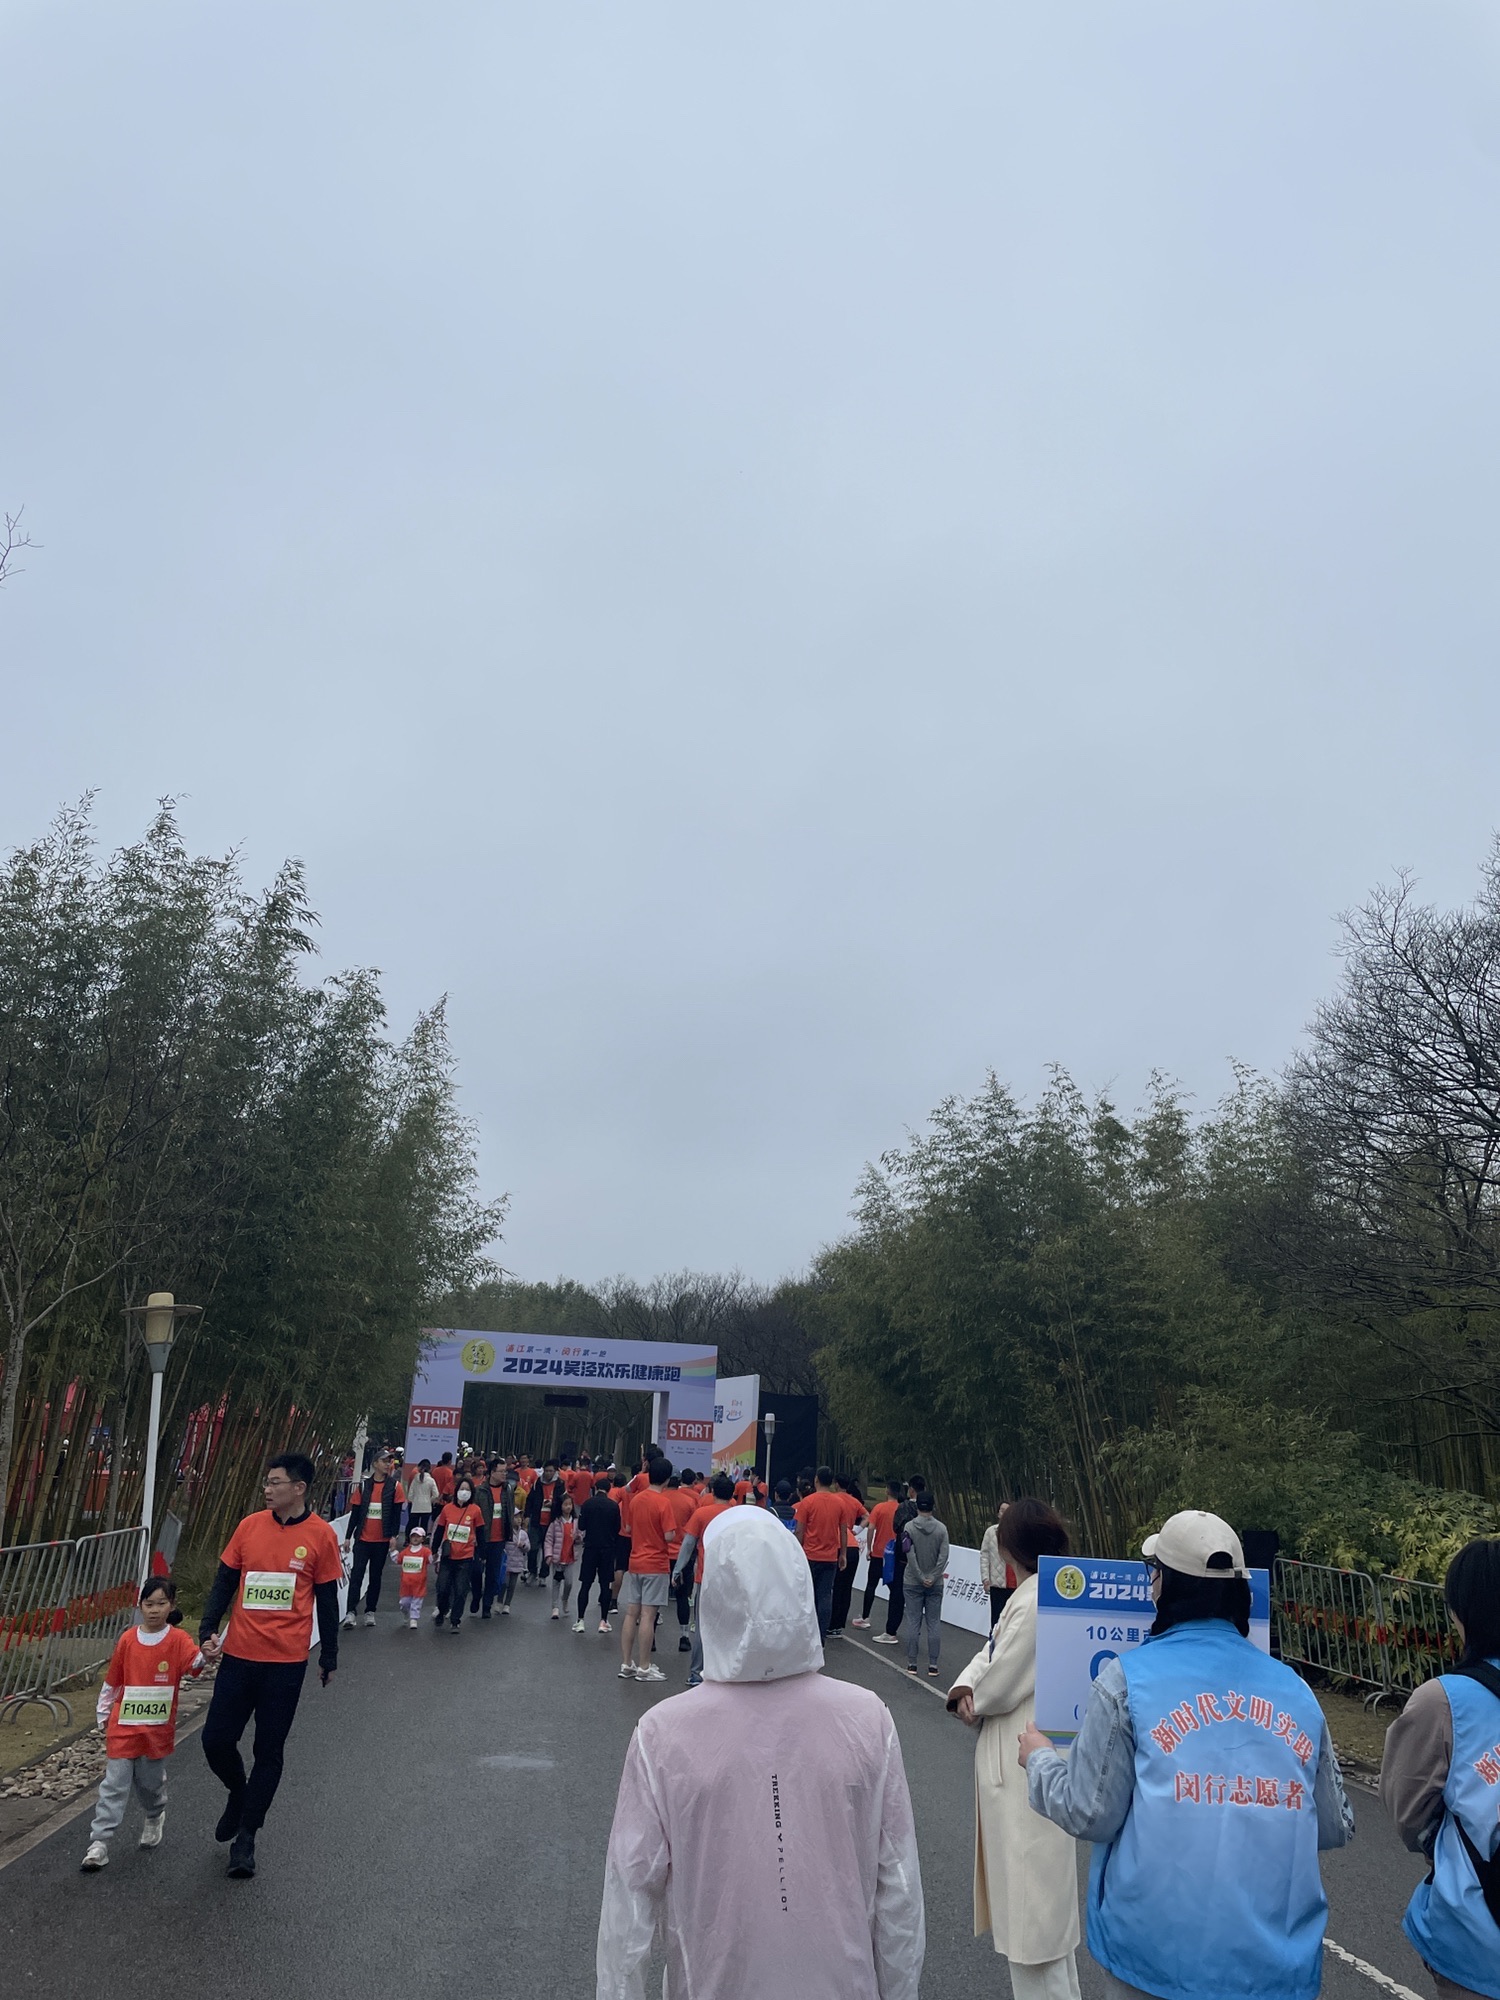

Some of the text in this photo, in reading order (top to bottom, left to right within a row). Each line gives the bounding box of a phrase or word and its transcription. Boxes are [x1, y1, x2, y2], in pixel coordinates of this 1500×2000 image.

[503, 1357, 681, 1382] 2024吴泾欢乐健康跑
[413, 1409, 460, 1425] START
[669, 1422, 712, 1438] START
[246, 1588, 291, 1601] F1043C
[123, 1703, 167, 1715] F1043A
[1150, 1690, 1314, 1767] 新时代文明实践
[1174, 1770, 1305, 1811] 闵行志愿者
[771, 1774, 788, 1912] TREKKING PELLIOT
